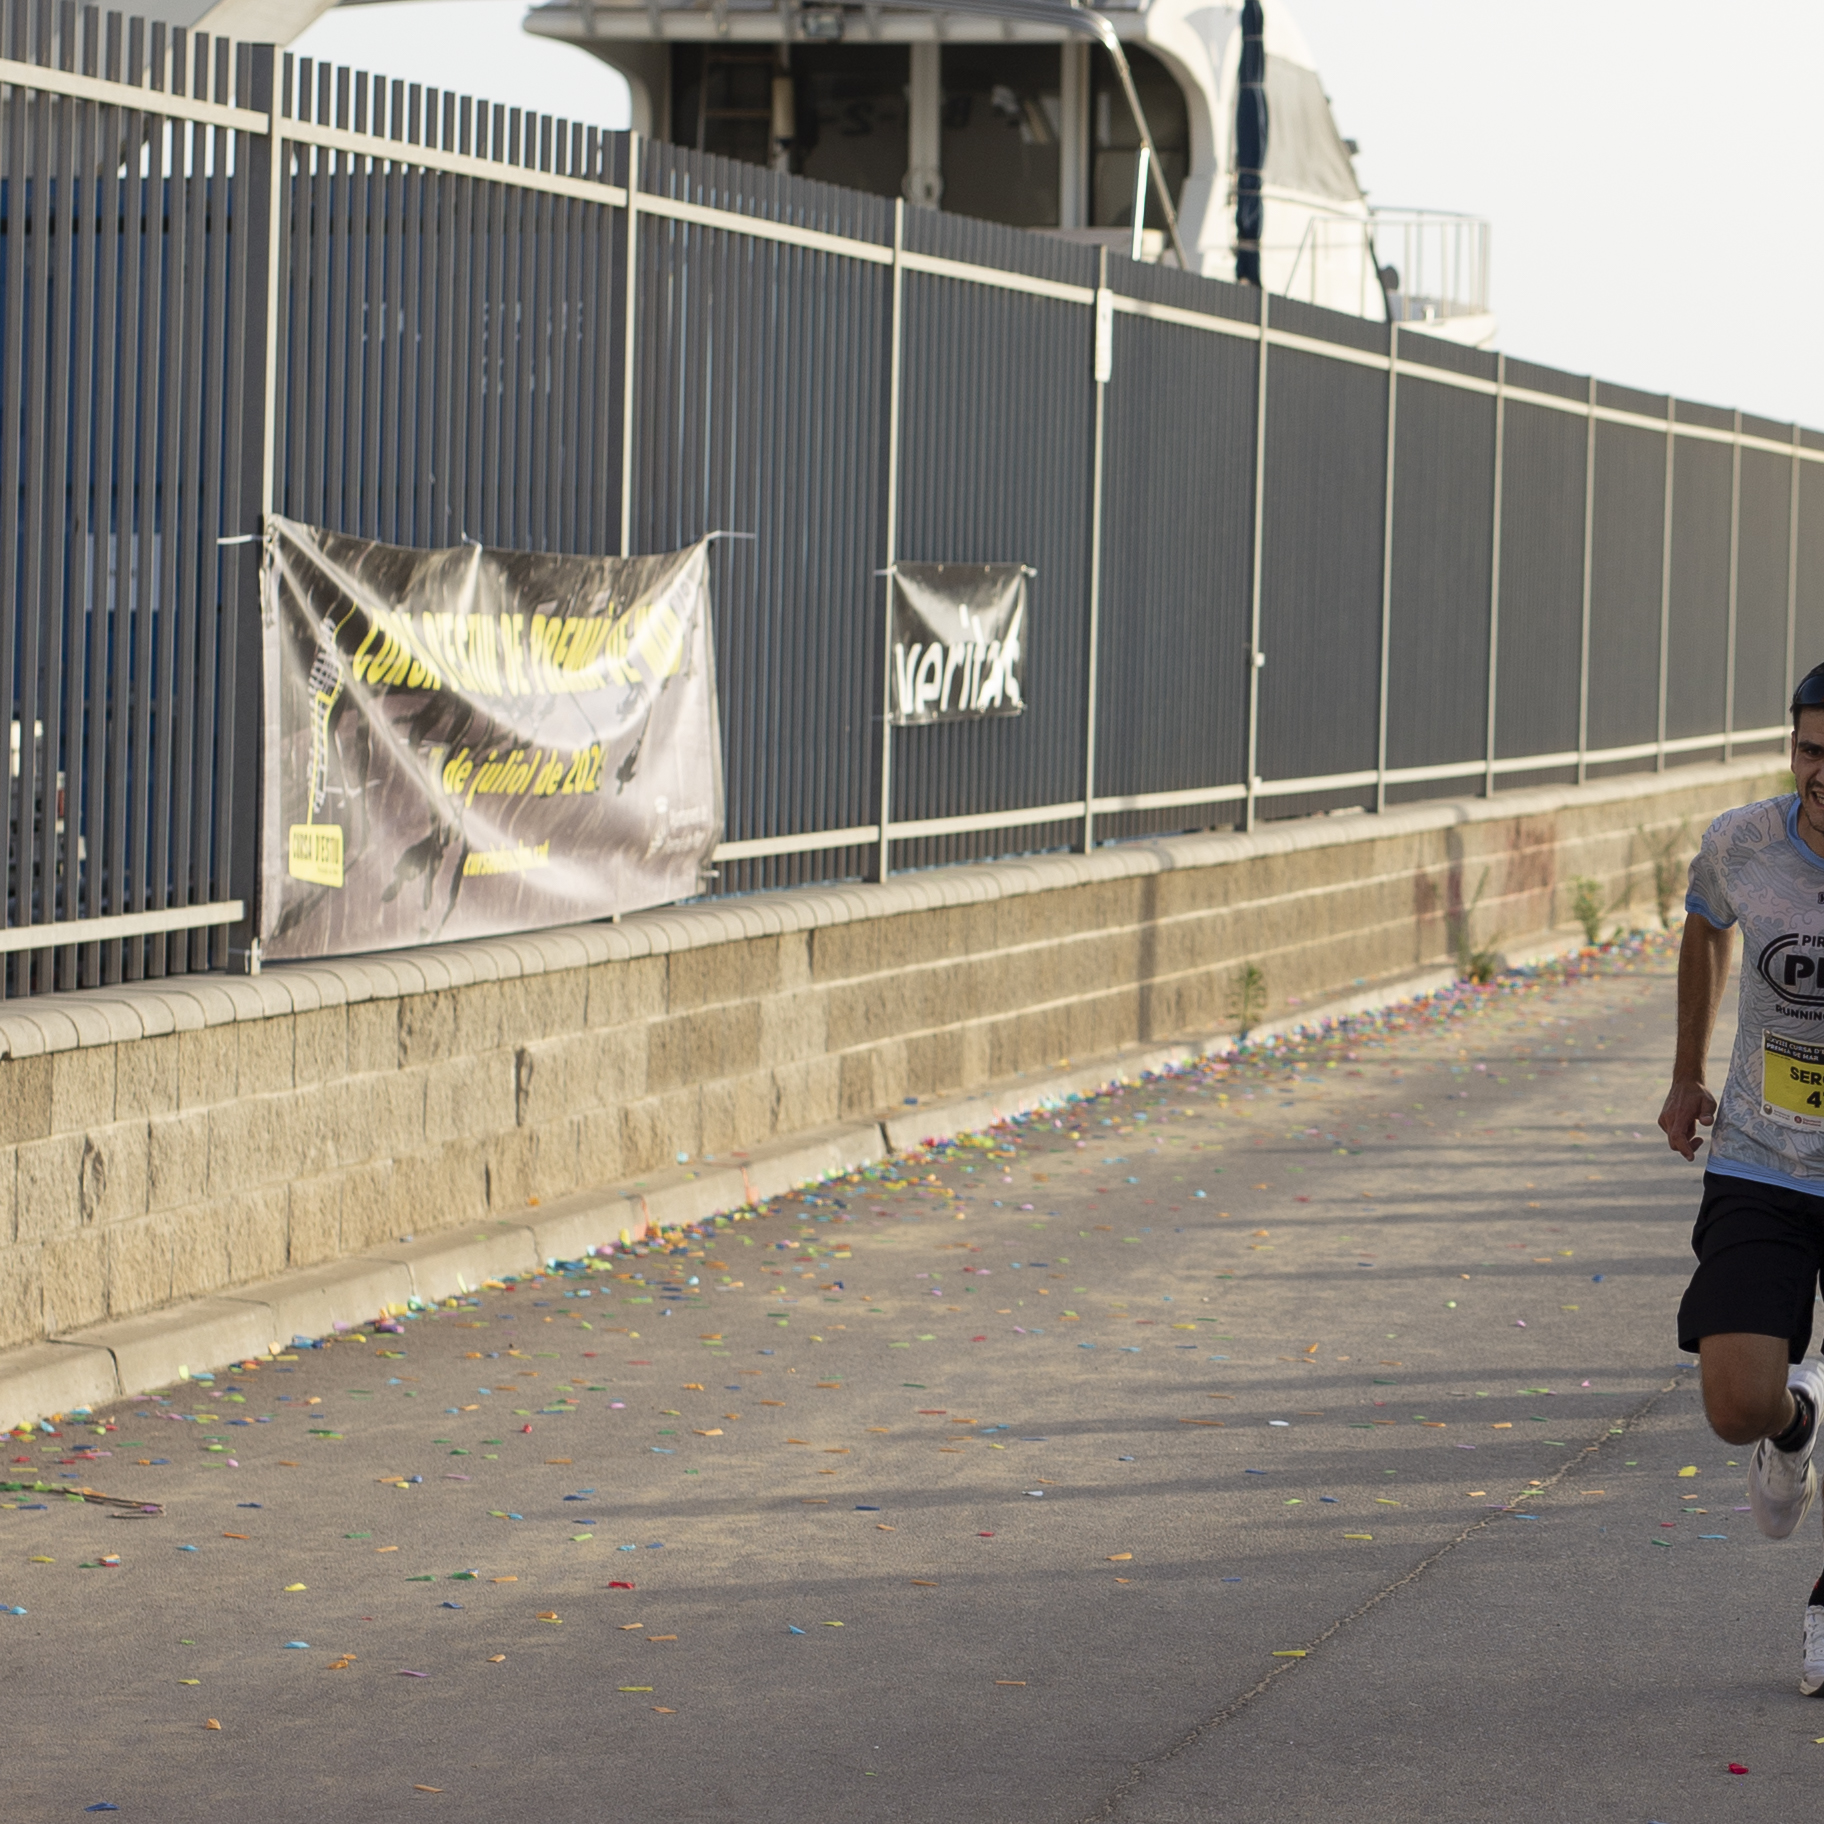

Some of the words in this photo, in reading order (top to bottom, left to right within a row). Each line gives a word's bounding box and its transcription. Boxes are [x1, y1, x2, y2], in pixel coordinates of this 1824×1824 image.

[353, 607, 441, 691] CURSA
[500, 613, 531, 697] DE
[442, 747, 474, 796] de
[465, 748, 542, 808] juliol
[533, 748, 564, 797] de
[1789, 1043, 1813, 1054] CURSA
[1802, 1054, 1819, 1062] MAR
